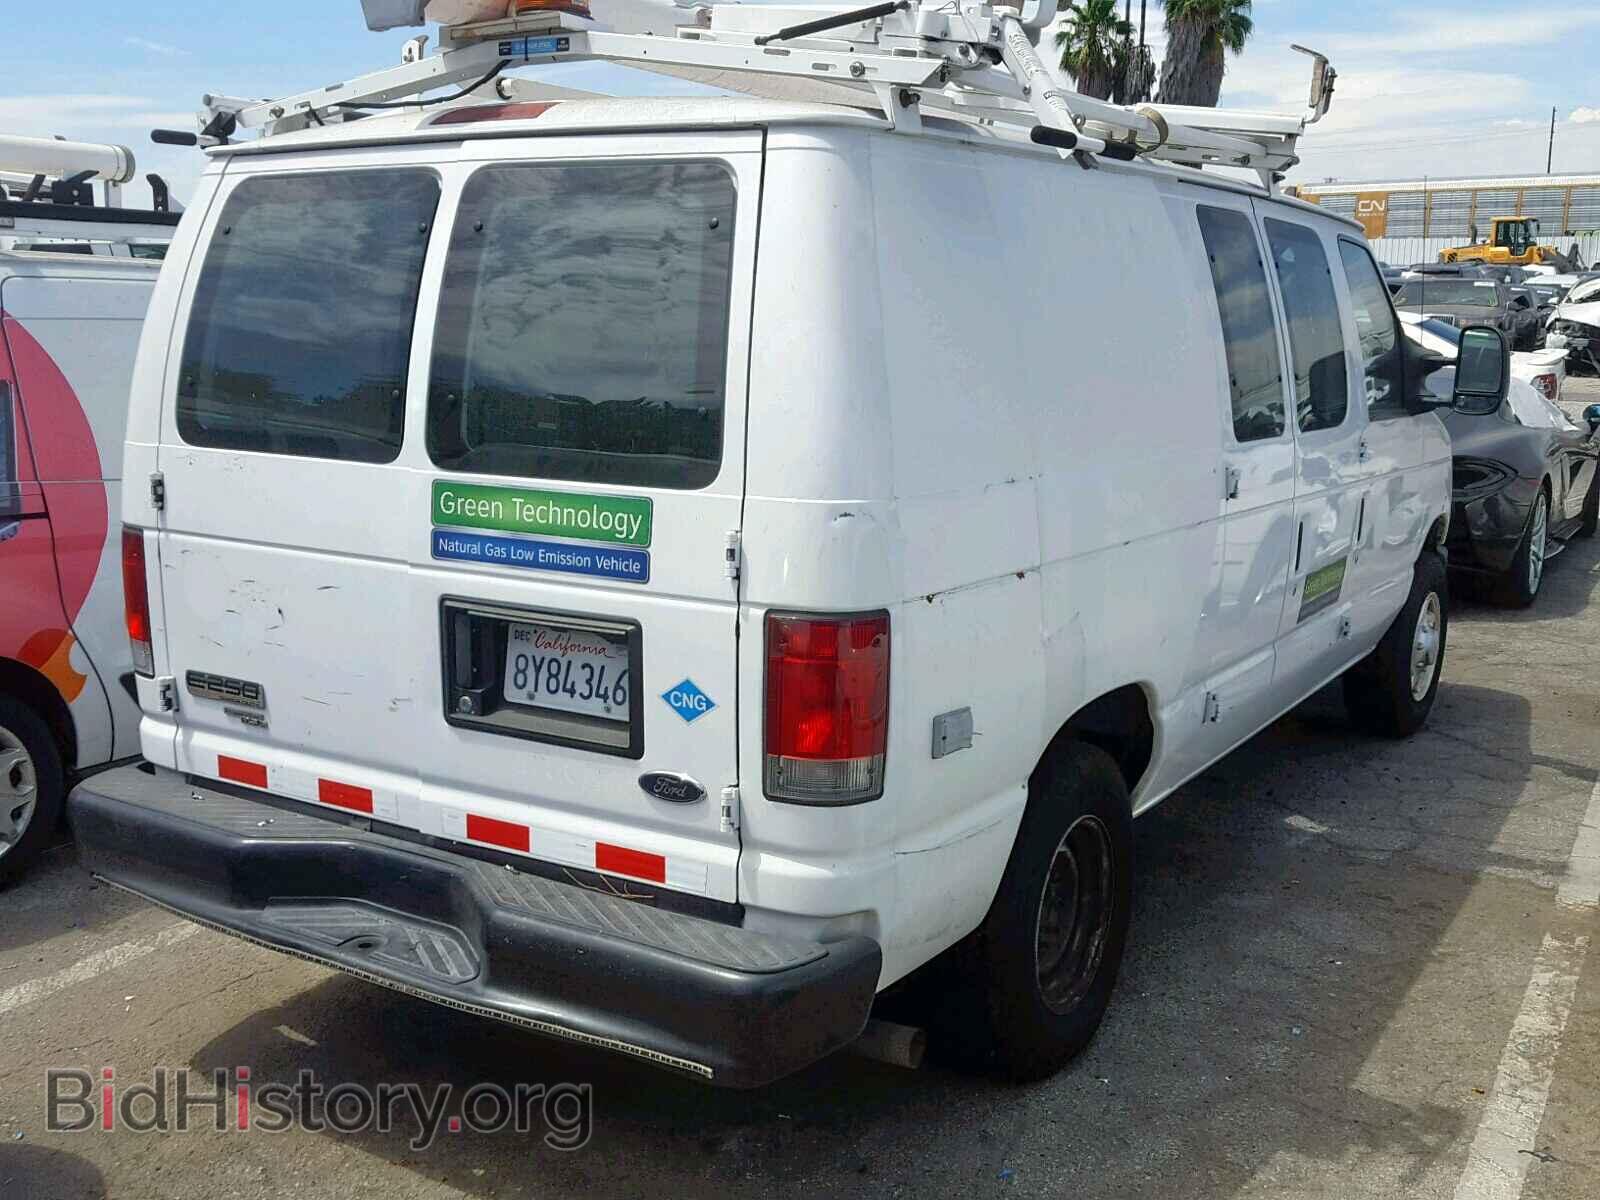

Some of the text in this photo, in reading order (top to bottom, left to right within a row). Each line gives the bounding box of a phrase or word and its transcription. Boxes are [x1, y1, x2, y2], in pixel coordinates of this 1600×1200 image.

[1359, 199, 1385, 211] CN
[440, 491, 643, 540] Green Technology
[439, 538, 641, 574] Natural Gas Low Emission Vehicle
[514, 629, 531, 642] DEC
[534, 629, 610, 658] California
[513, 653, 629, 706] 8Y84346
[669, 690, 707, 711] CNG
[653, 776, 688, 797] Ford
